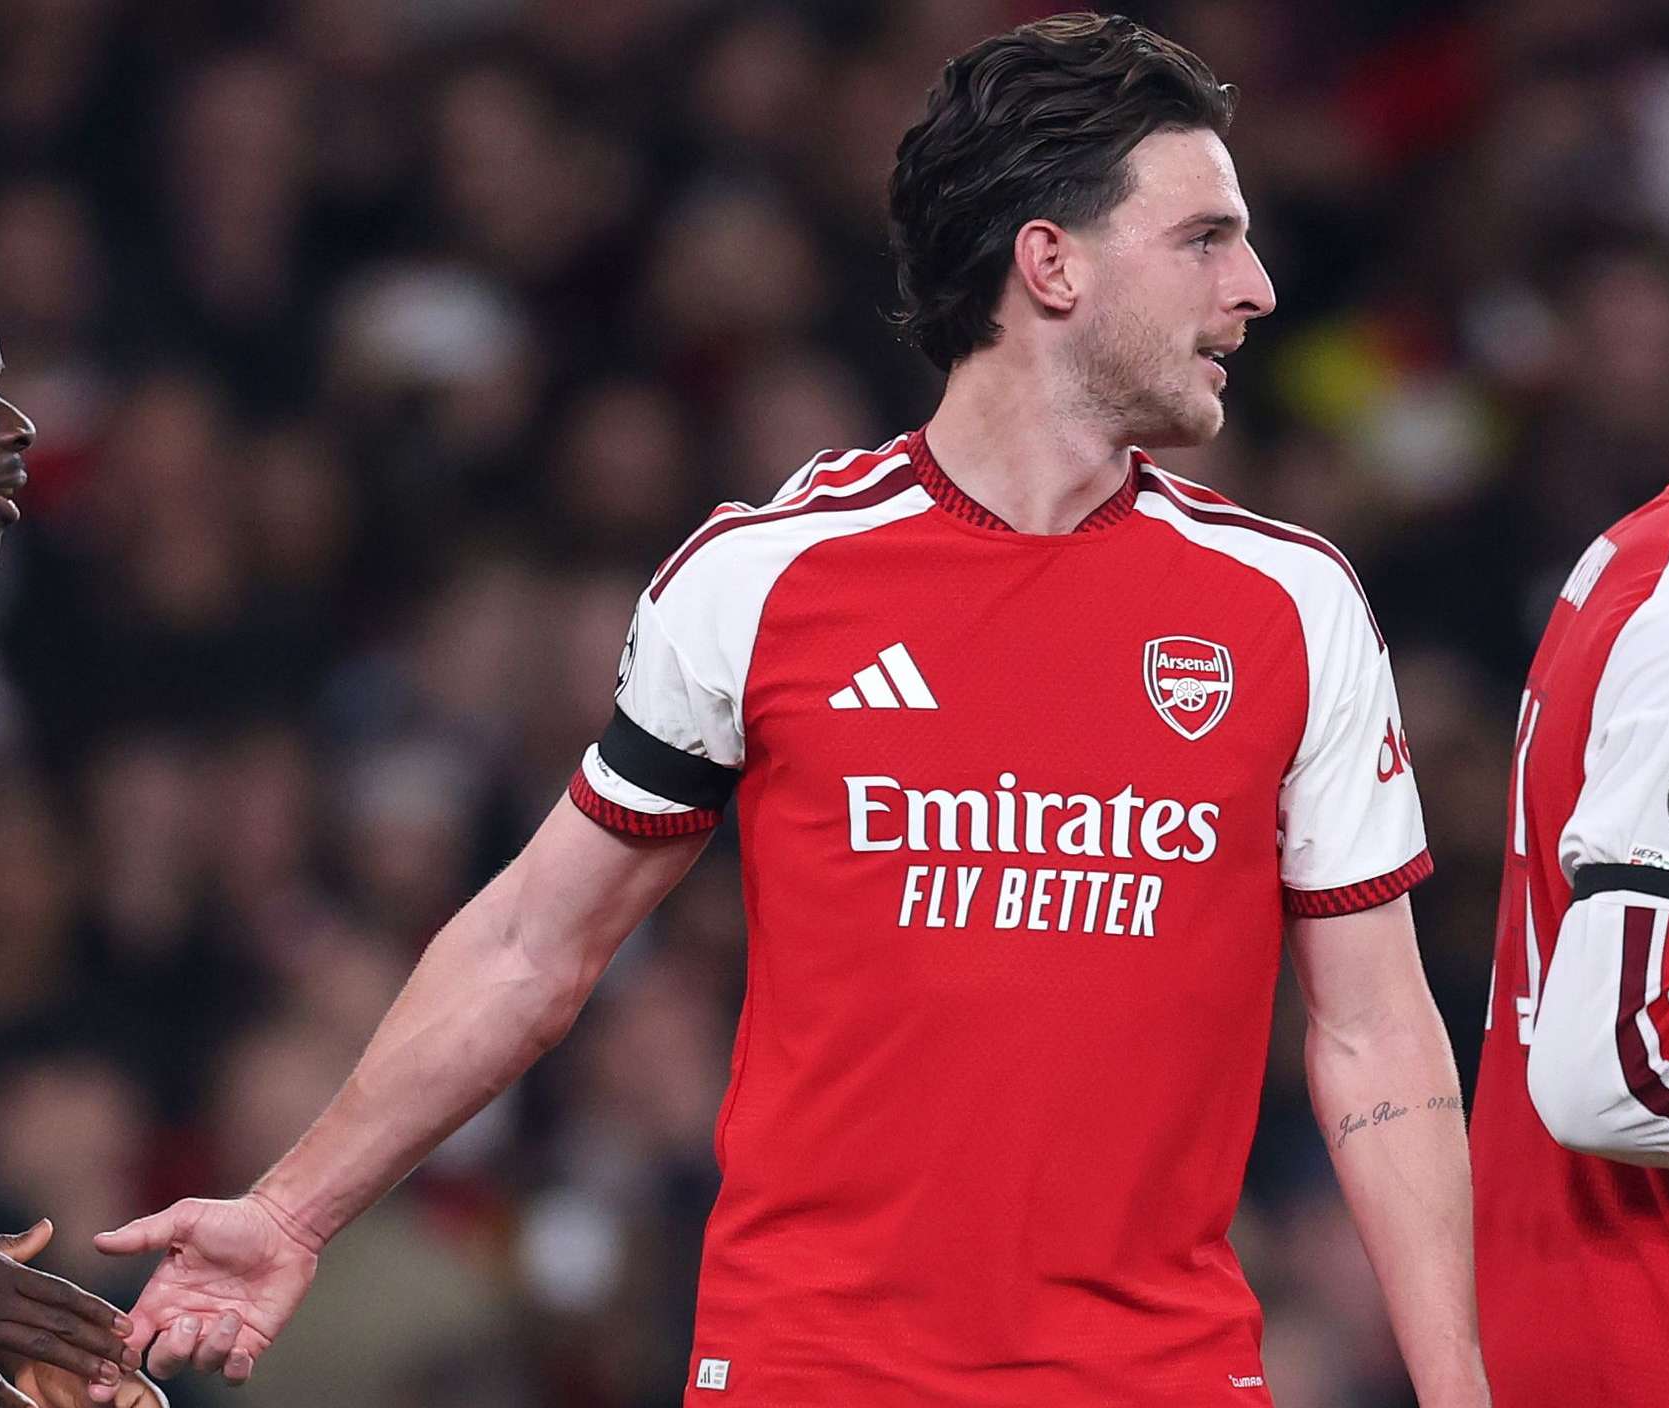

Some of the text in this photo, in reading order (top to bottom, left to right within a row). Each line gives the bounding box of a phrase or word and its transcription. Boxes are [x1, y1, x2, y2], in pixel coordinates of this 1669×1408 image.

[1157, 652, 1220, 672] Arsenal
[844, 772, 1221, 864] Emirates
[898, 866, 1163, 938] FLY BETTER
